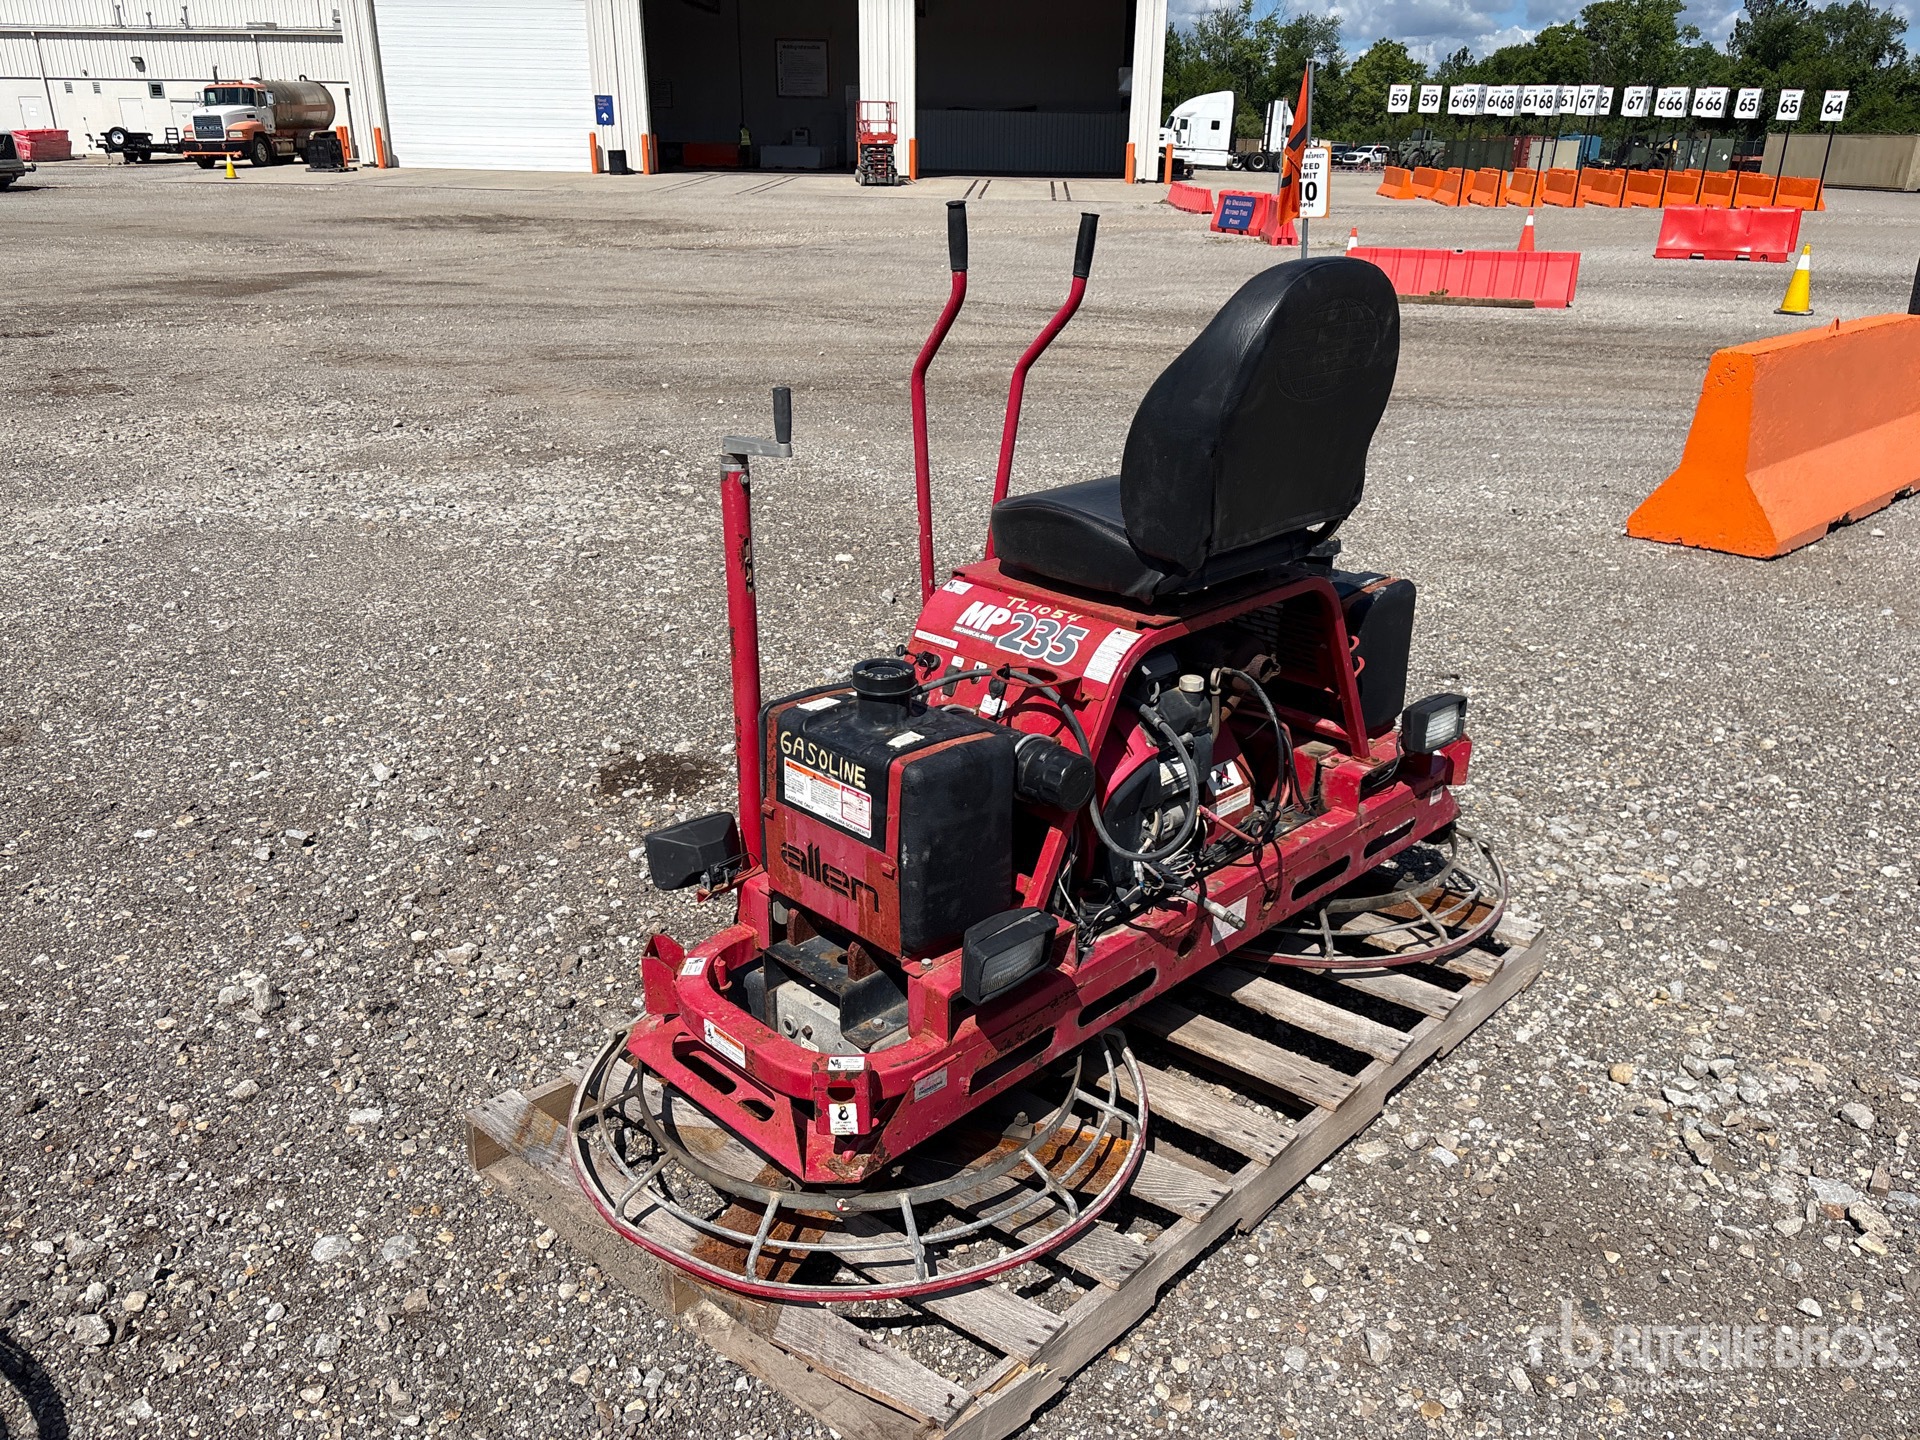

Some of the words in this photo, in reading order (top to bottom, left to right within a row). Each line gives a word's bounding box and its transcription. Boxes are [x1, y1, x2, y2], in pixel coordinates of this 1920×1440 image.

[1391, 94, 1408, 106] 59
[1421, 94, 1438, 106] 59
[1462, 94, 1476, 108] 69
[1500, 96, 1514, 109] 68
[1523, 94, 1538, 106] 61
[1539, 95, 1553, 108] 68
[1560, 95, 1574, 107] 61
[1580, 95, 1595, 108] 67
[1628, 96, 1643, 110] 67
[1666, 97, 1682, 110] 66
[1706, 97, 1722, 110] 66
[1740, 98, 1756, 112] 65
[1781, 100, 1798, 113] 65
[1825, 101, 1842, 114] 64
[780, 731, 866, 789] GASOLINE
[781, 842, 880, 912] allen
